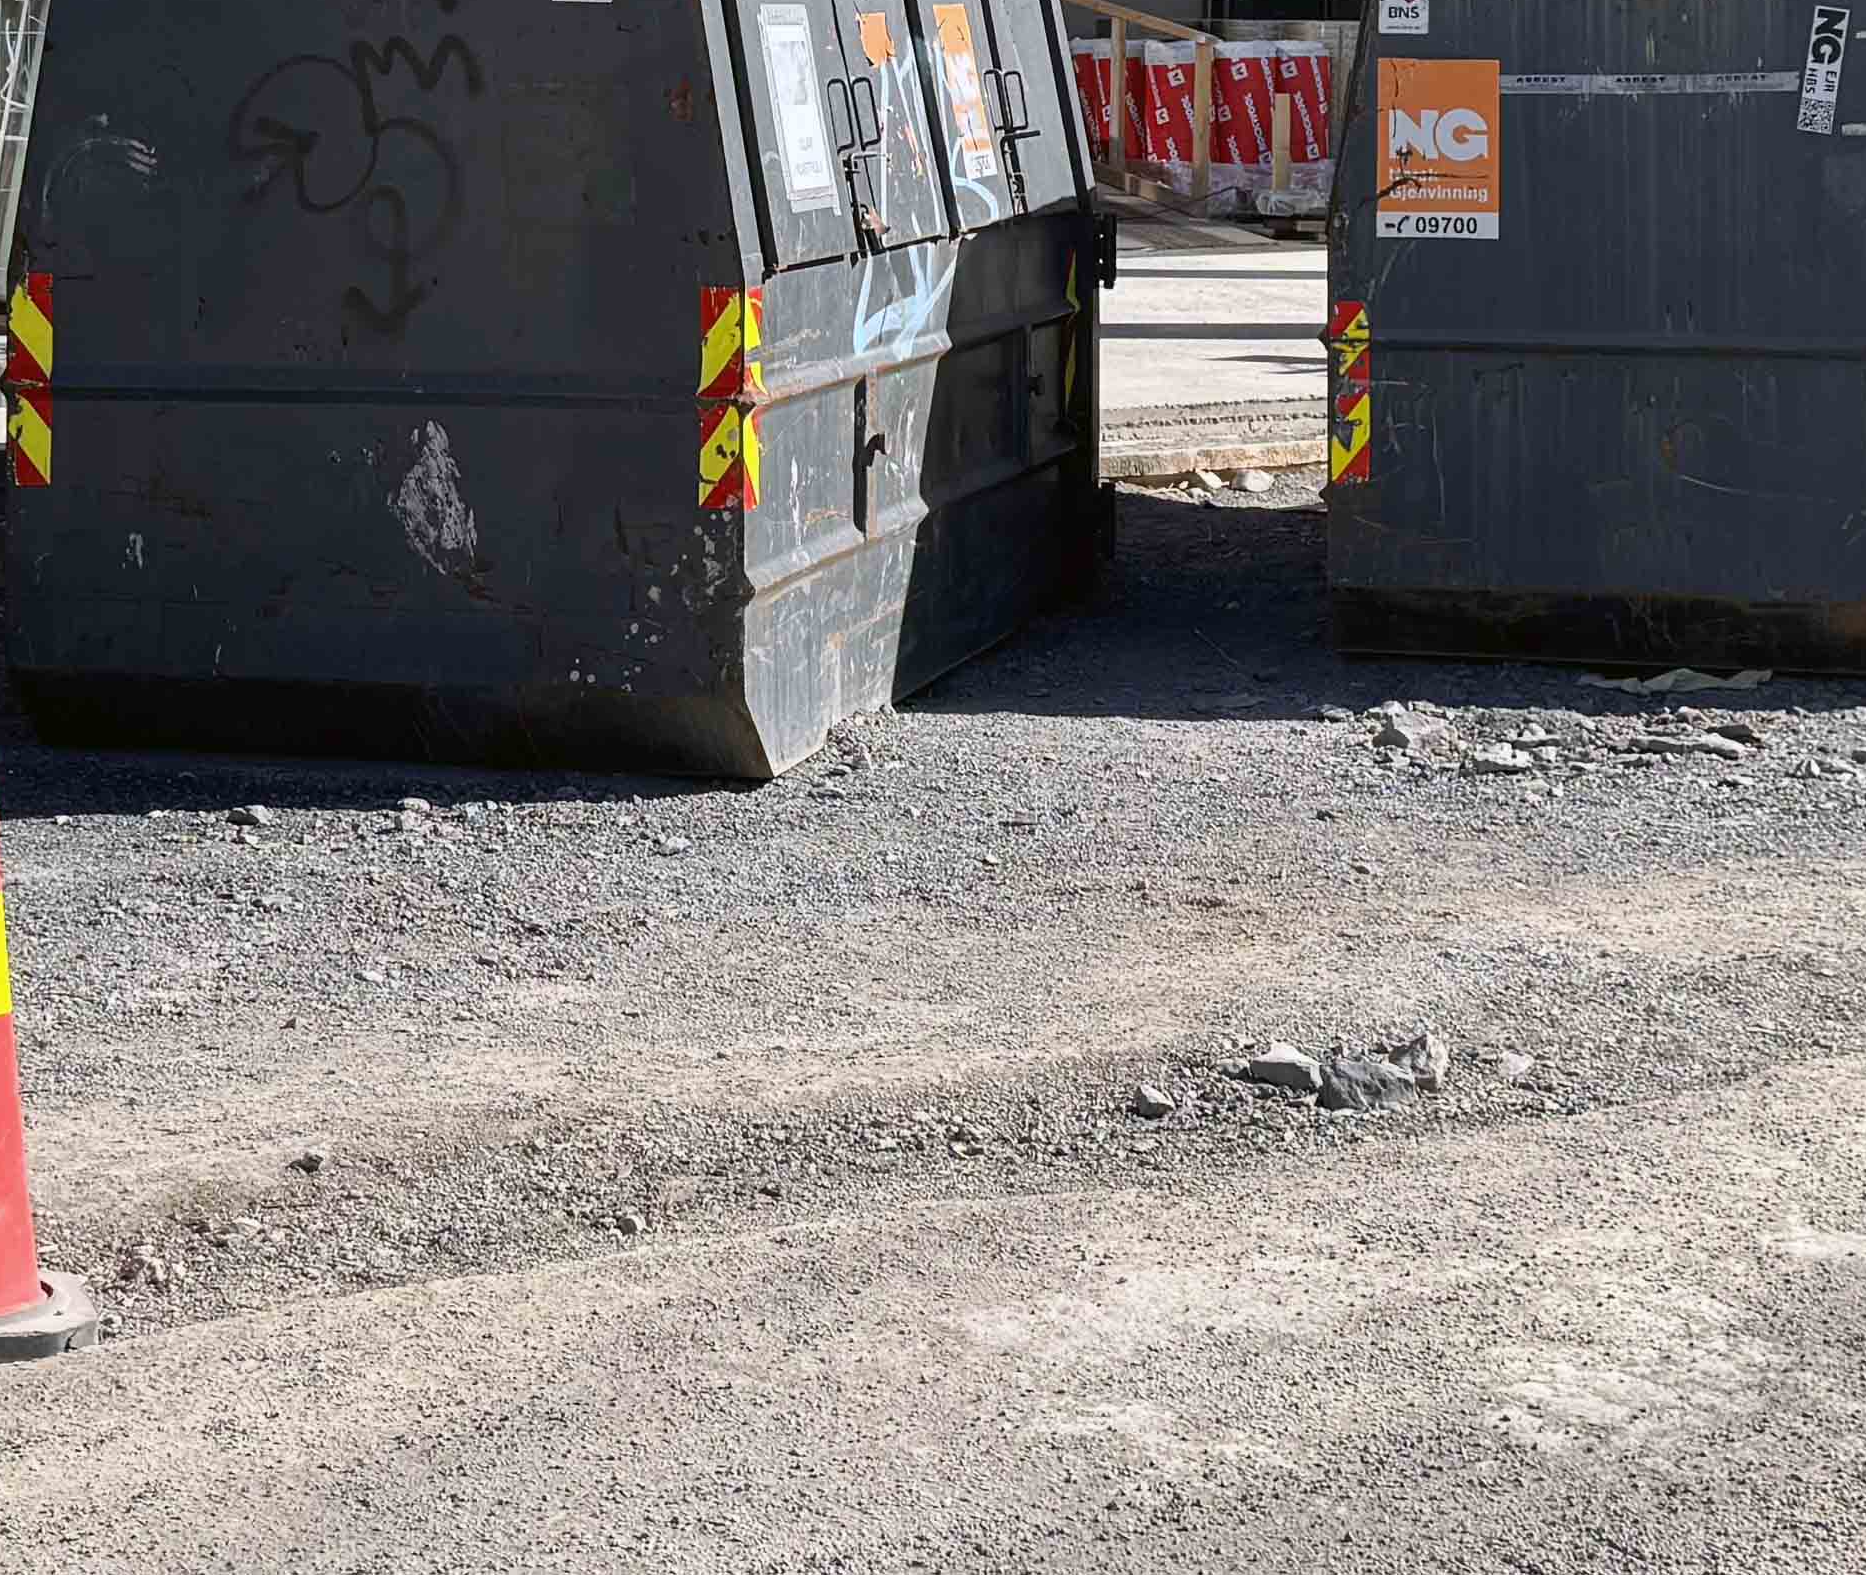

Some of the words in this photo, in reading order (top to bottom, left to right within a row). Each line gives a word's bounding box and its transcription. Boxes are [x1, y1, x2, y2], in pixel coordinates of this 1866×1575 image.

[1388, 6, 1420, 19] BNS
[1811, 8, 1847, 65] NG
[1389, 108, 1488, 161] NG
[1415, 216, 1478, 234] 09700
